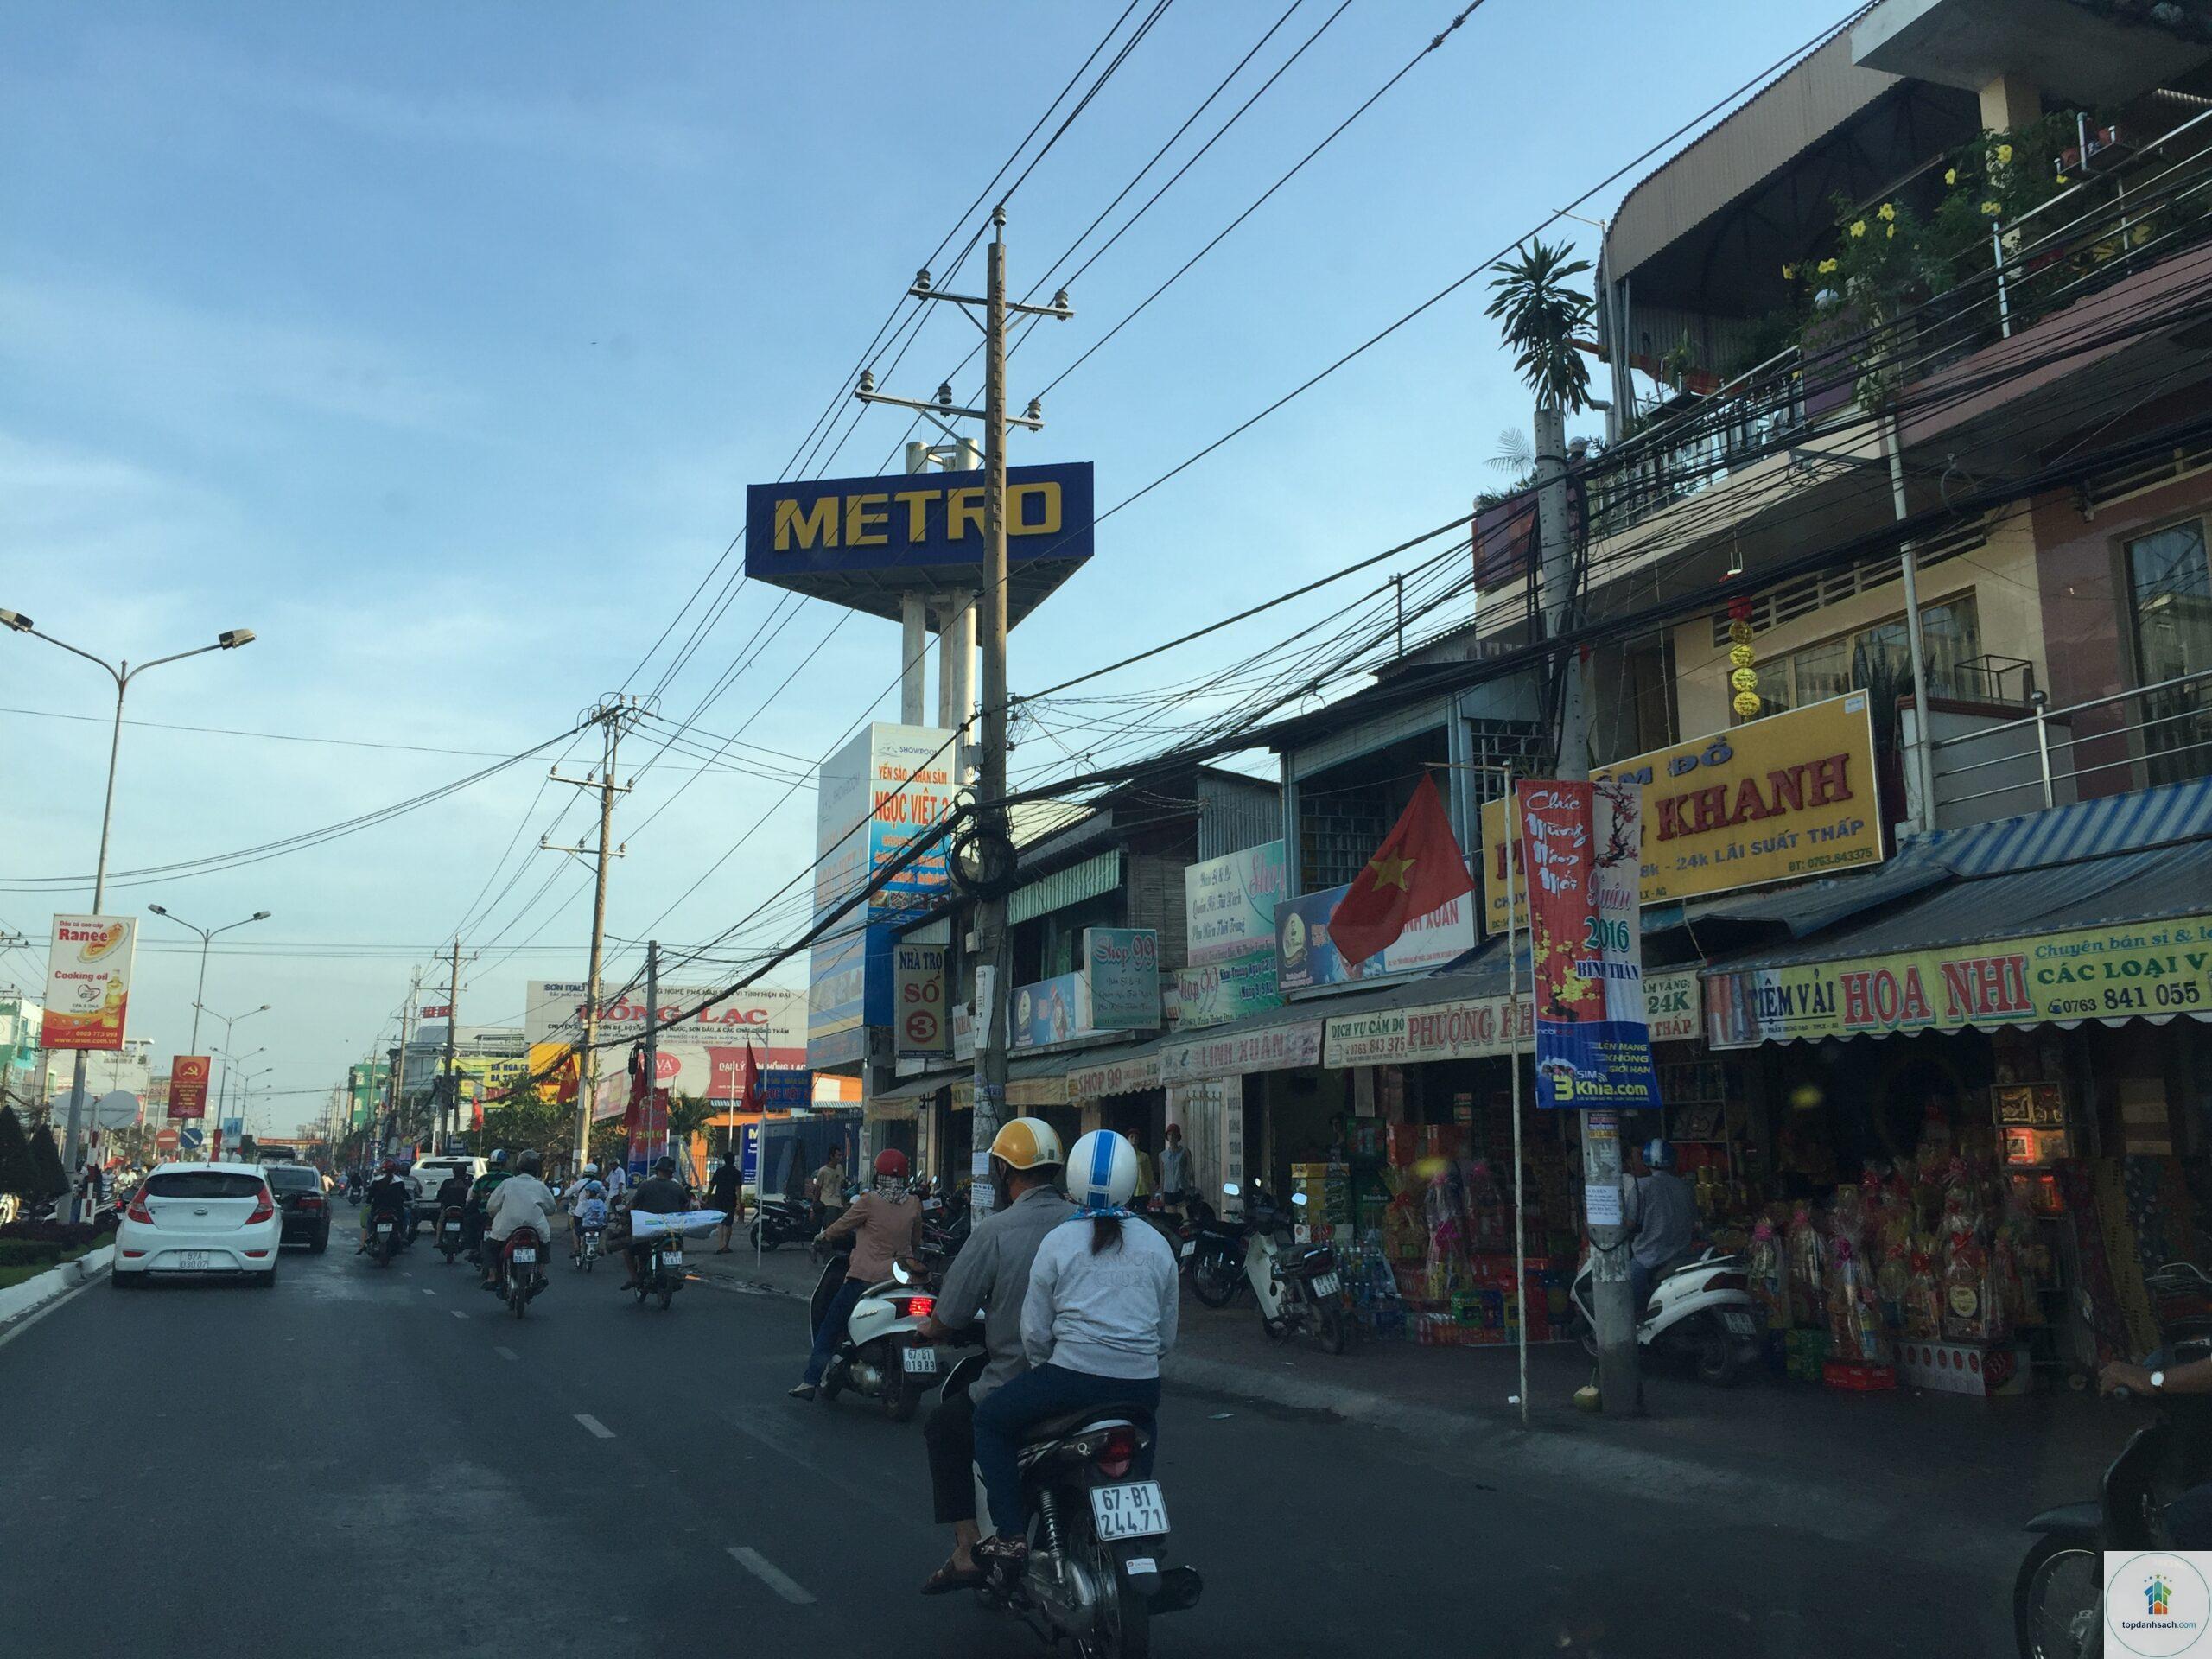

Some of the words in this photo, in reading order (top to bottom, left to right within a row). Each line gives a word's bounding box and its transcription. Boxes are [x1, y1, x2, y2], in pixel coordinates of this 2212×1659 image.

[773, 481, 1062, 551] METRO
[1669, 736, 1734, 777] ĐỒ
[874, 791, 906, 829] NGỌC
[942, 797, 949, 823] 2
[1526, 790, 1581, 810] Chúc
[1655, 753, 1854, 842] KHANH
[1714, 843, 1745, 864] LÃI
[1751, 828, 1799, 857] SUẤT
[1807, 816, 1865, 843] THẤP
[58, 928, 108, 942] Ranee
[1584, 916, 1630, 953] 2016
[2035, 939, 2104, 957] Chuyên
[2109, 934, 2146, 949] bán
[2174, 929, 2193, 942] &
[899, 948, 920, 969] NHÀ
[923, 952, 942, 974] TRỌ
[1093, 936, 1132, 968] Shop
[1131, 934, 1156, 971] 99
[54, 970, 94, 982] Cooking
[96, 972, 108, 981] oil
[2037, 962, 2095, 985] CÁC
[2102, 956, 2178, 978] LOẠI
[904, 975, 940, 1003] SỐ
[1647, 990, 1691, 1014] 24K
[1796, 968, 1836, 1014] VẢI
[1840, 965, 1936, 1028] HOA
[1940, 953, 2037, 1021] NHI
[2063, 998, 2097, 1013] 0763
[2103, 986, 2148, 1010] 841
[2156, 980, 2200, 1007] 055
[696, 1007, 769, 1027] LẠC
[911, 1016, 934, 1039] 3
[1332, 1020, 1351, 1040] DỊCH
[1353, 1021, 1366, 1037] VỤ
[1407, 1003, 1497, 1056] PHƯỢNG
[1655, 1012, 1692, 1037] THẤP
[1201, 1041, 1233, 1068] LINH
[1238, 1031, 1285, 1063] XUÂN
[1387, 1036, 1406, 1052] 375
[1605, 1052, 1649, 1063] KHÔNG
[1553, 1074, 1574, 1101] 3
[1577, 1070, 1598, 1079] SIM
[1102, 1485, 1151, 1510] 67-B1
[1101, 1509, 1164, 1536] 244.71
